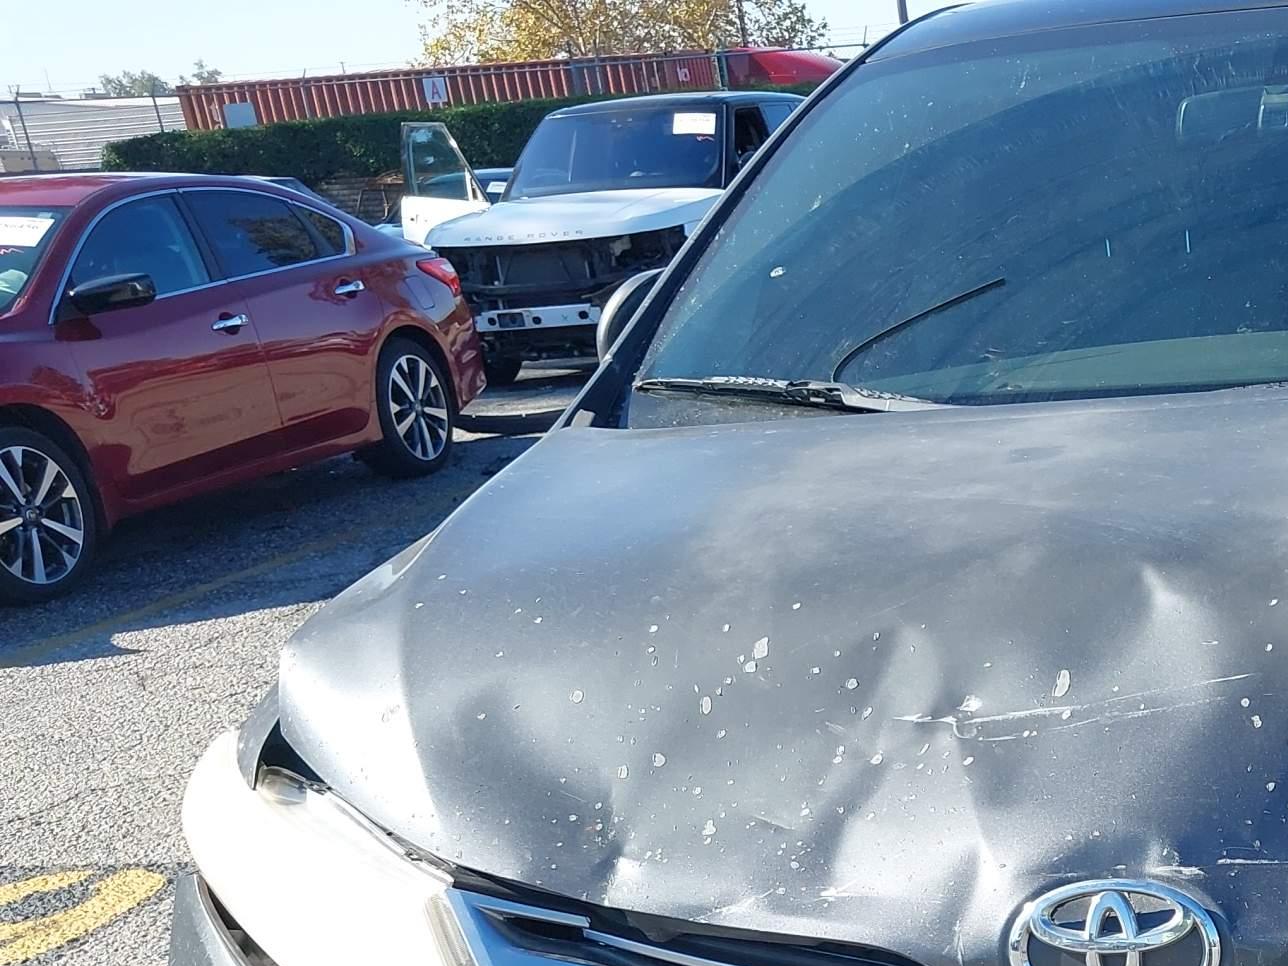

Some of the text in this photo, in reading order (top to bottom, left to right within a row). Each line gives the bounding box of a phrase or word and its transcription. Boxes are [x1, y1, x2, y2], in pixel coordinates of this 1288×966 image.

[431, 79, 442, 100] A
[463, 229, 584, 242] RANGE ROVER
